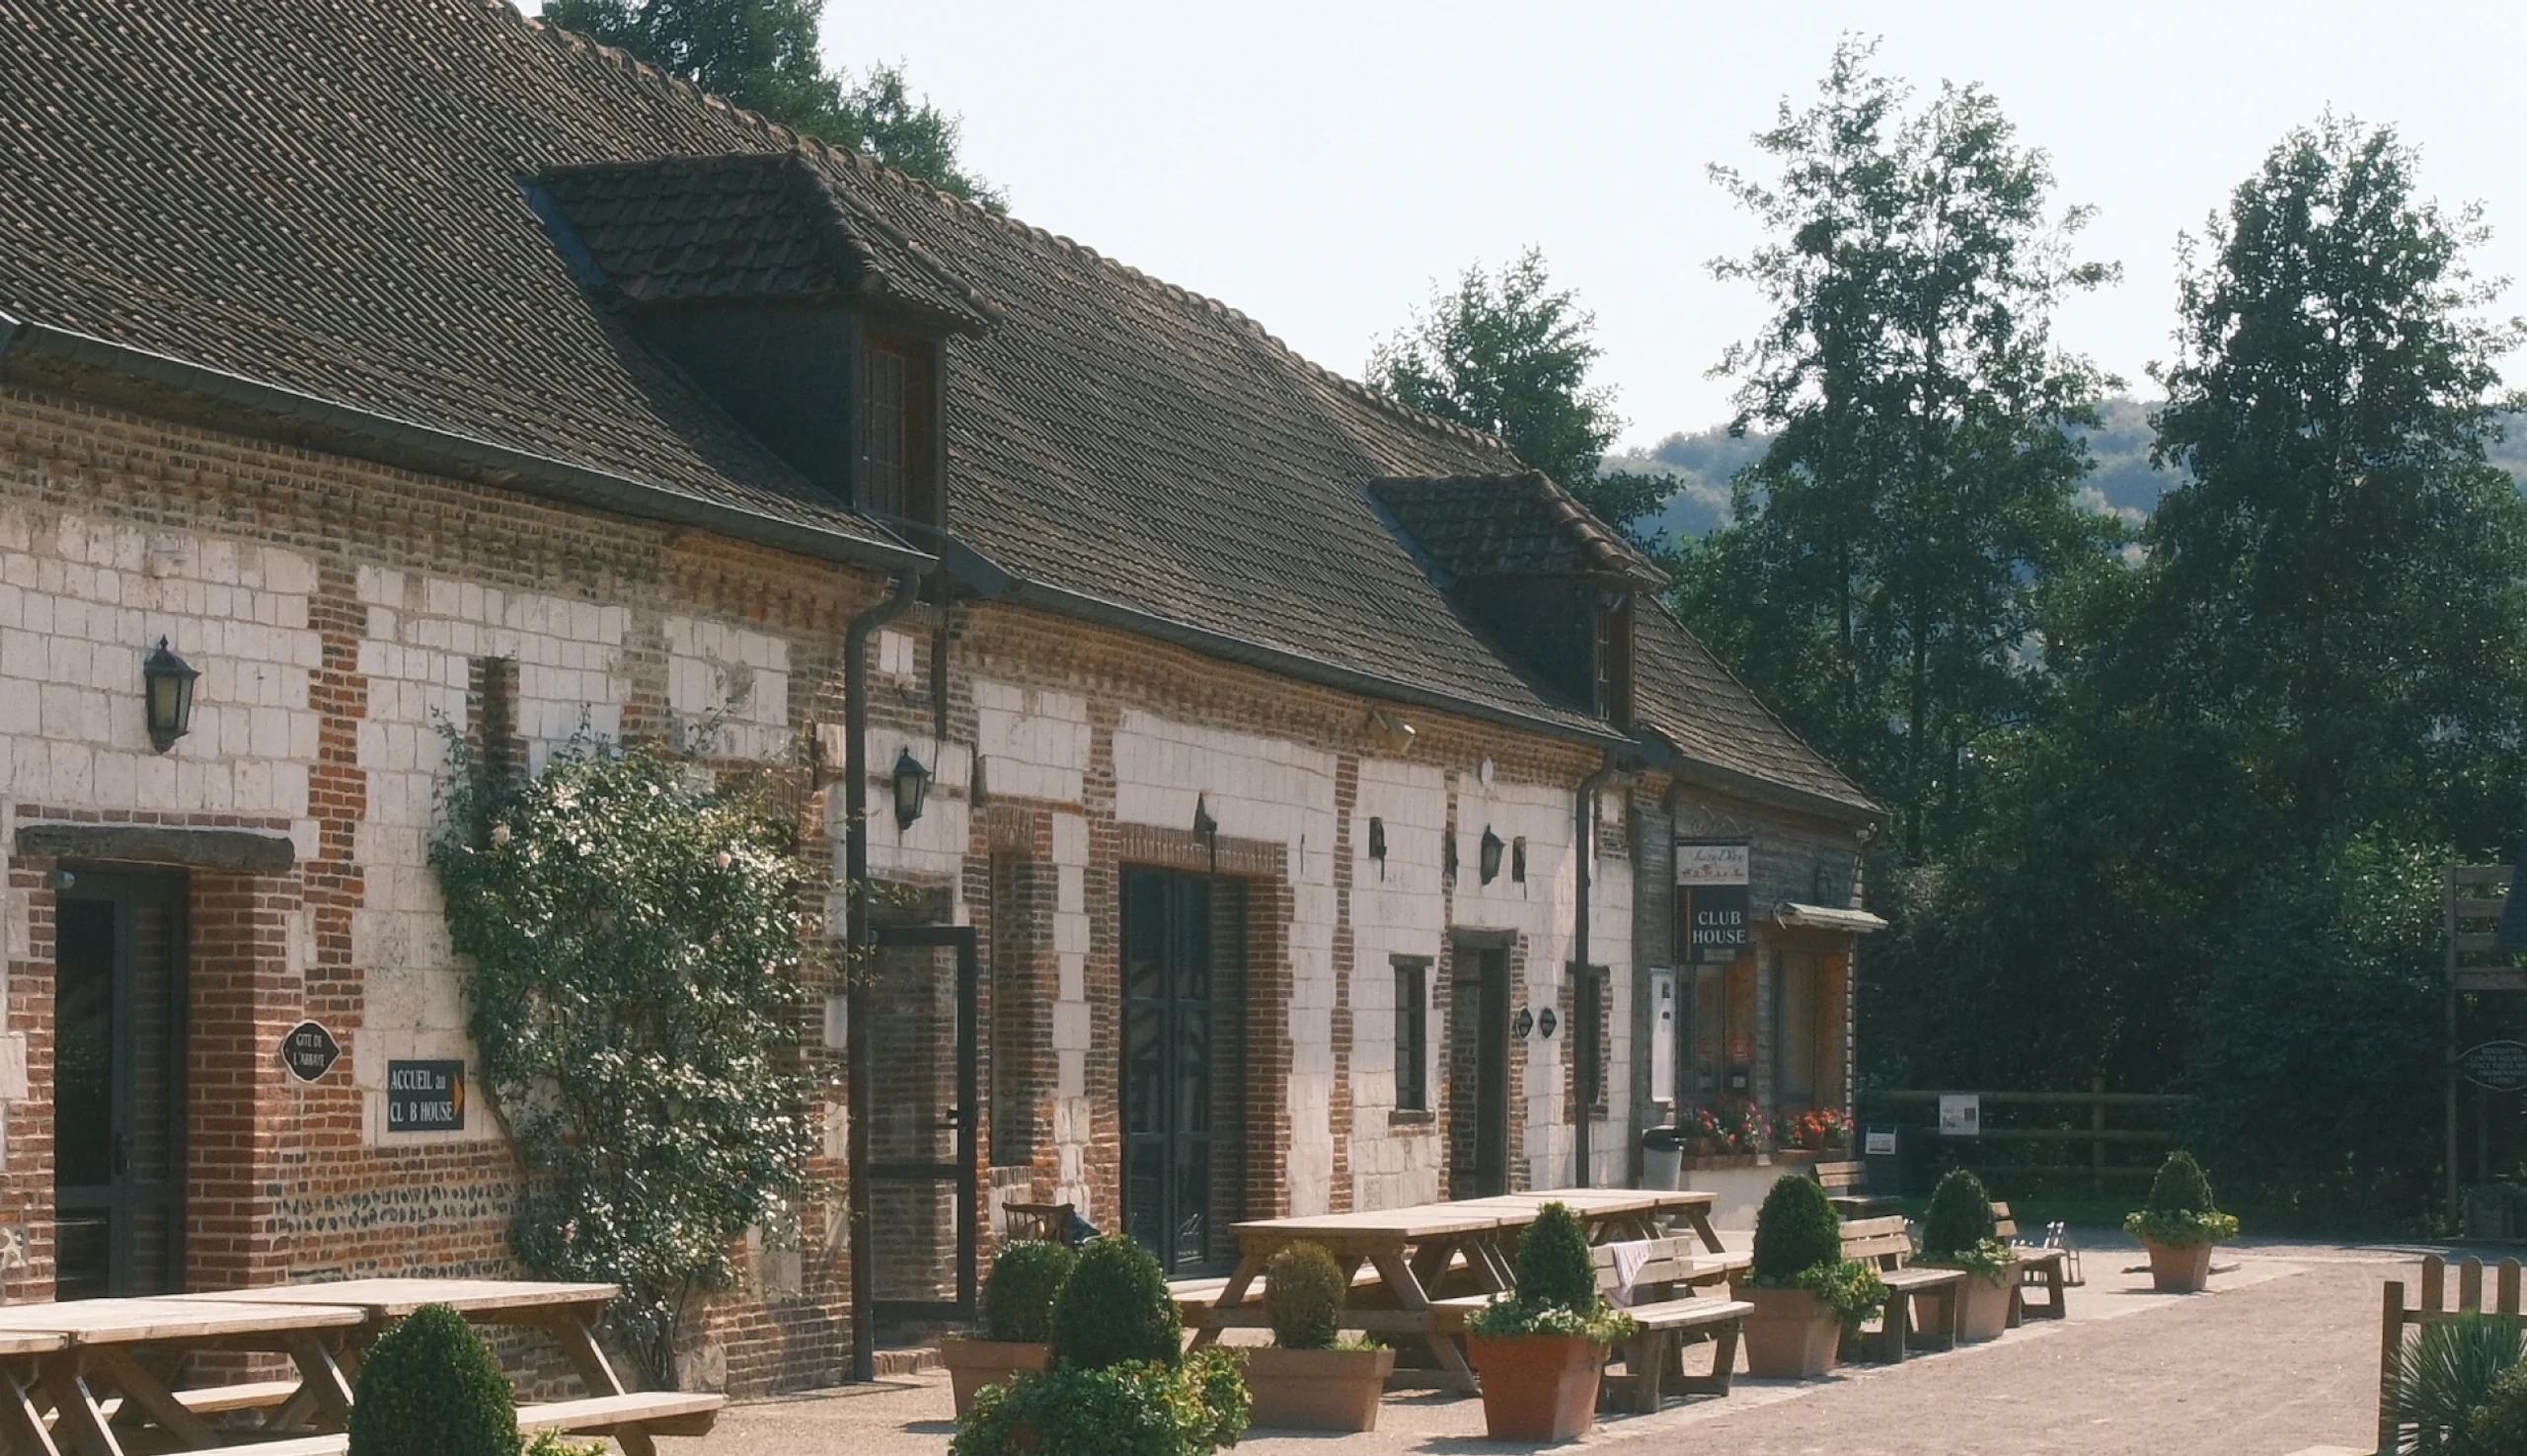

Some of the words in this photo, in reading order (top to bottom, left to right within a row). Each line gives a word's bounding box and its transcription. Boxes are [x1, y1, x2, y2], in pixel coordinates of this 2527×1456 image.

[1698, 911, 1741, 926] CLUB
[1692, 929, 1746, 945] HOUSE
[390, 1069, 432, 1090] ACCUEIL
[390, 1102, 418, 1122] CLB
[421, 1102, 453, 1121] HOUSE
